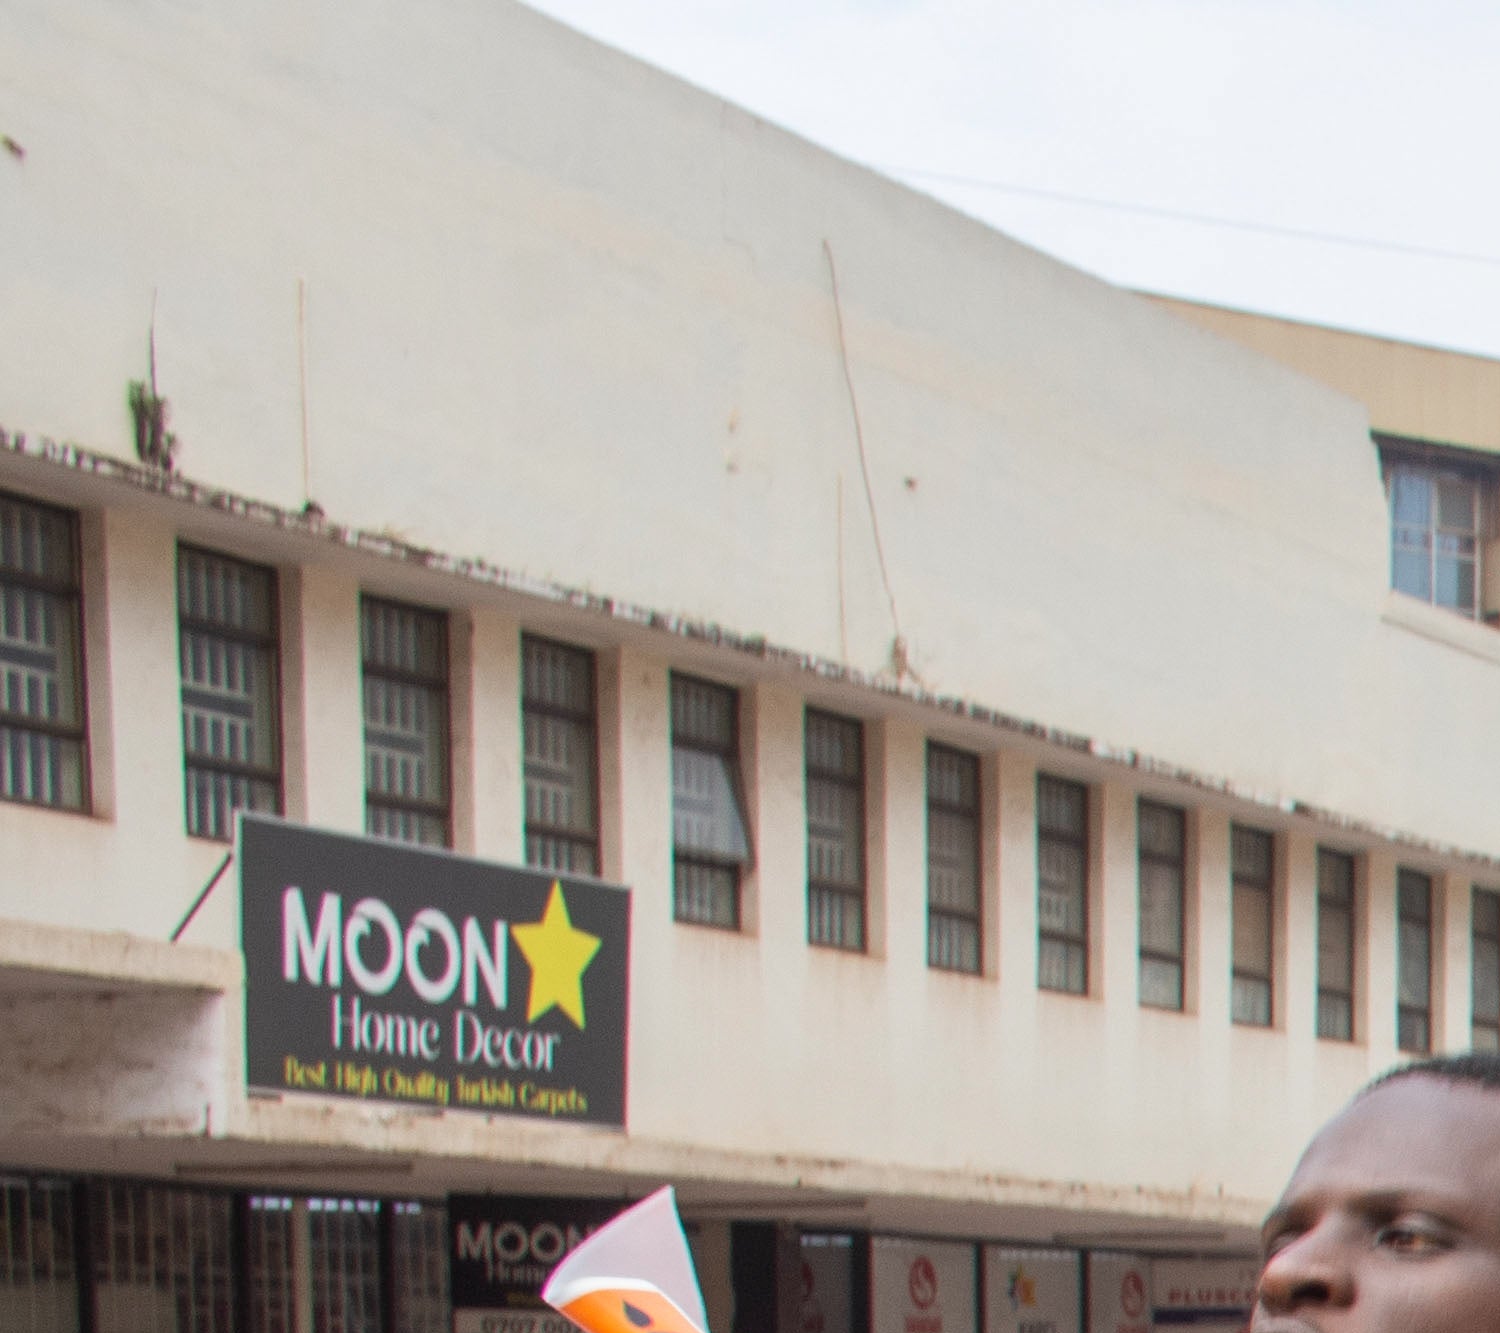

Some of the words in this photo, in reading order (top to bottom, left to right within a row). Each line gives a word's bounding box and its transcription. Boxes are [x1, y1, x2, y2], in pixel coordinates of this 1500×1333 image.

[283, 886, 508, 1010] MOON
[333, 994, 440, 1060] Home
[455, 1010, 560, 1072] Decor
[285, 1056, 327, 1086] Best
[335, 1060, 377, 1094] High
[384, 1067, 449, 1106] Quality
[457, 1074, 515, 1109] Turkish
[520, 1081, 588, 1115] Carpets
